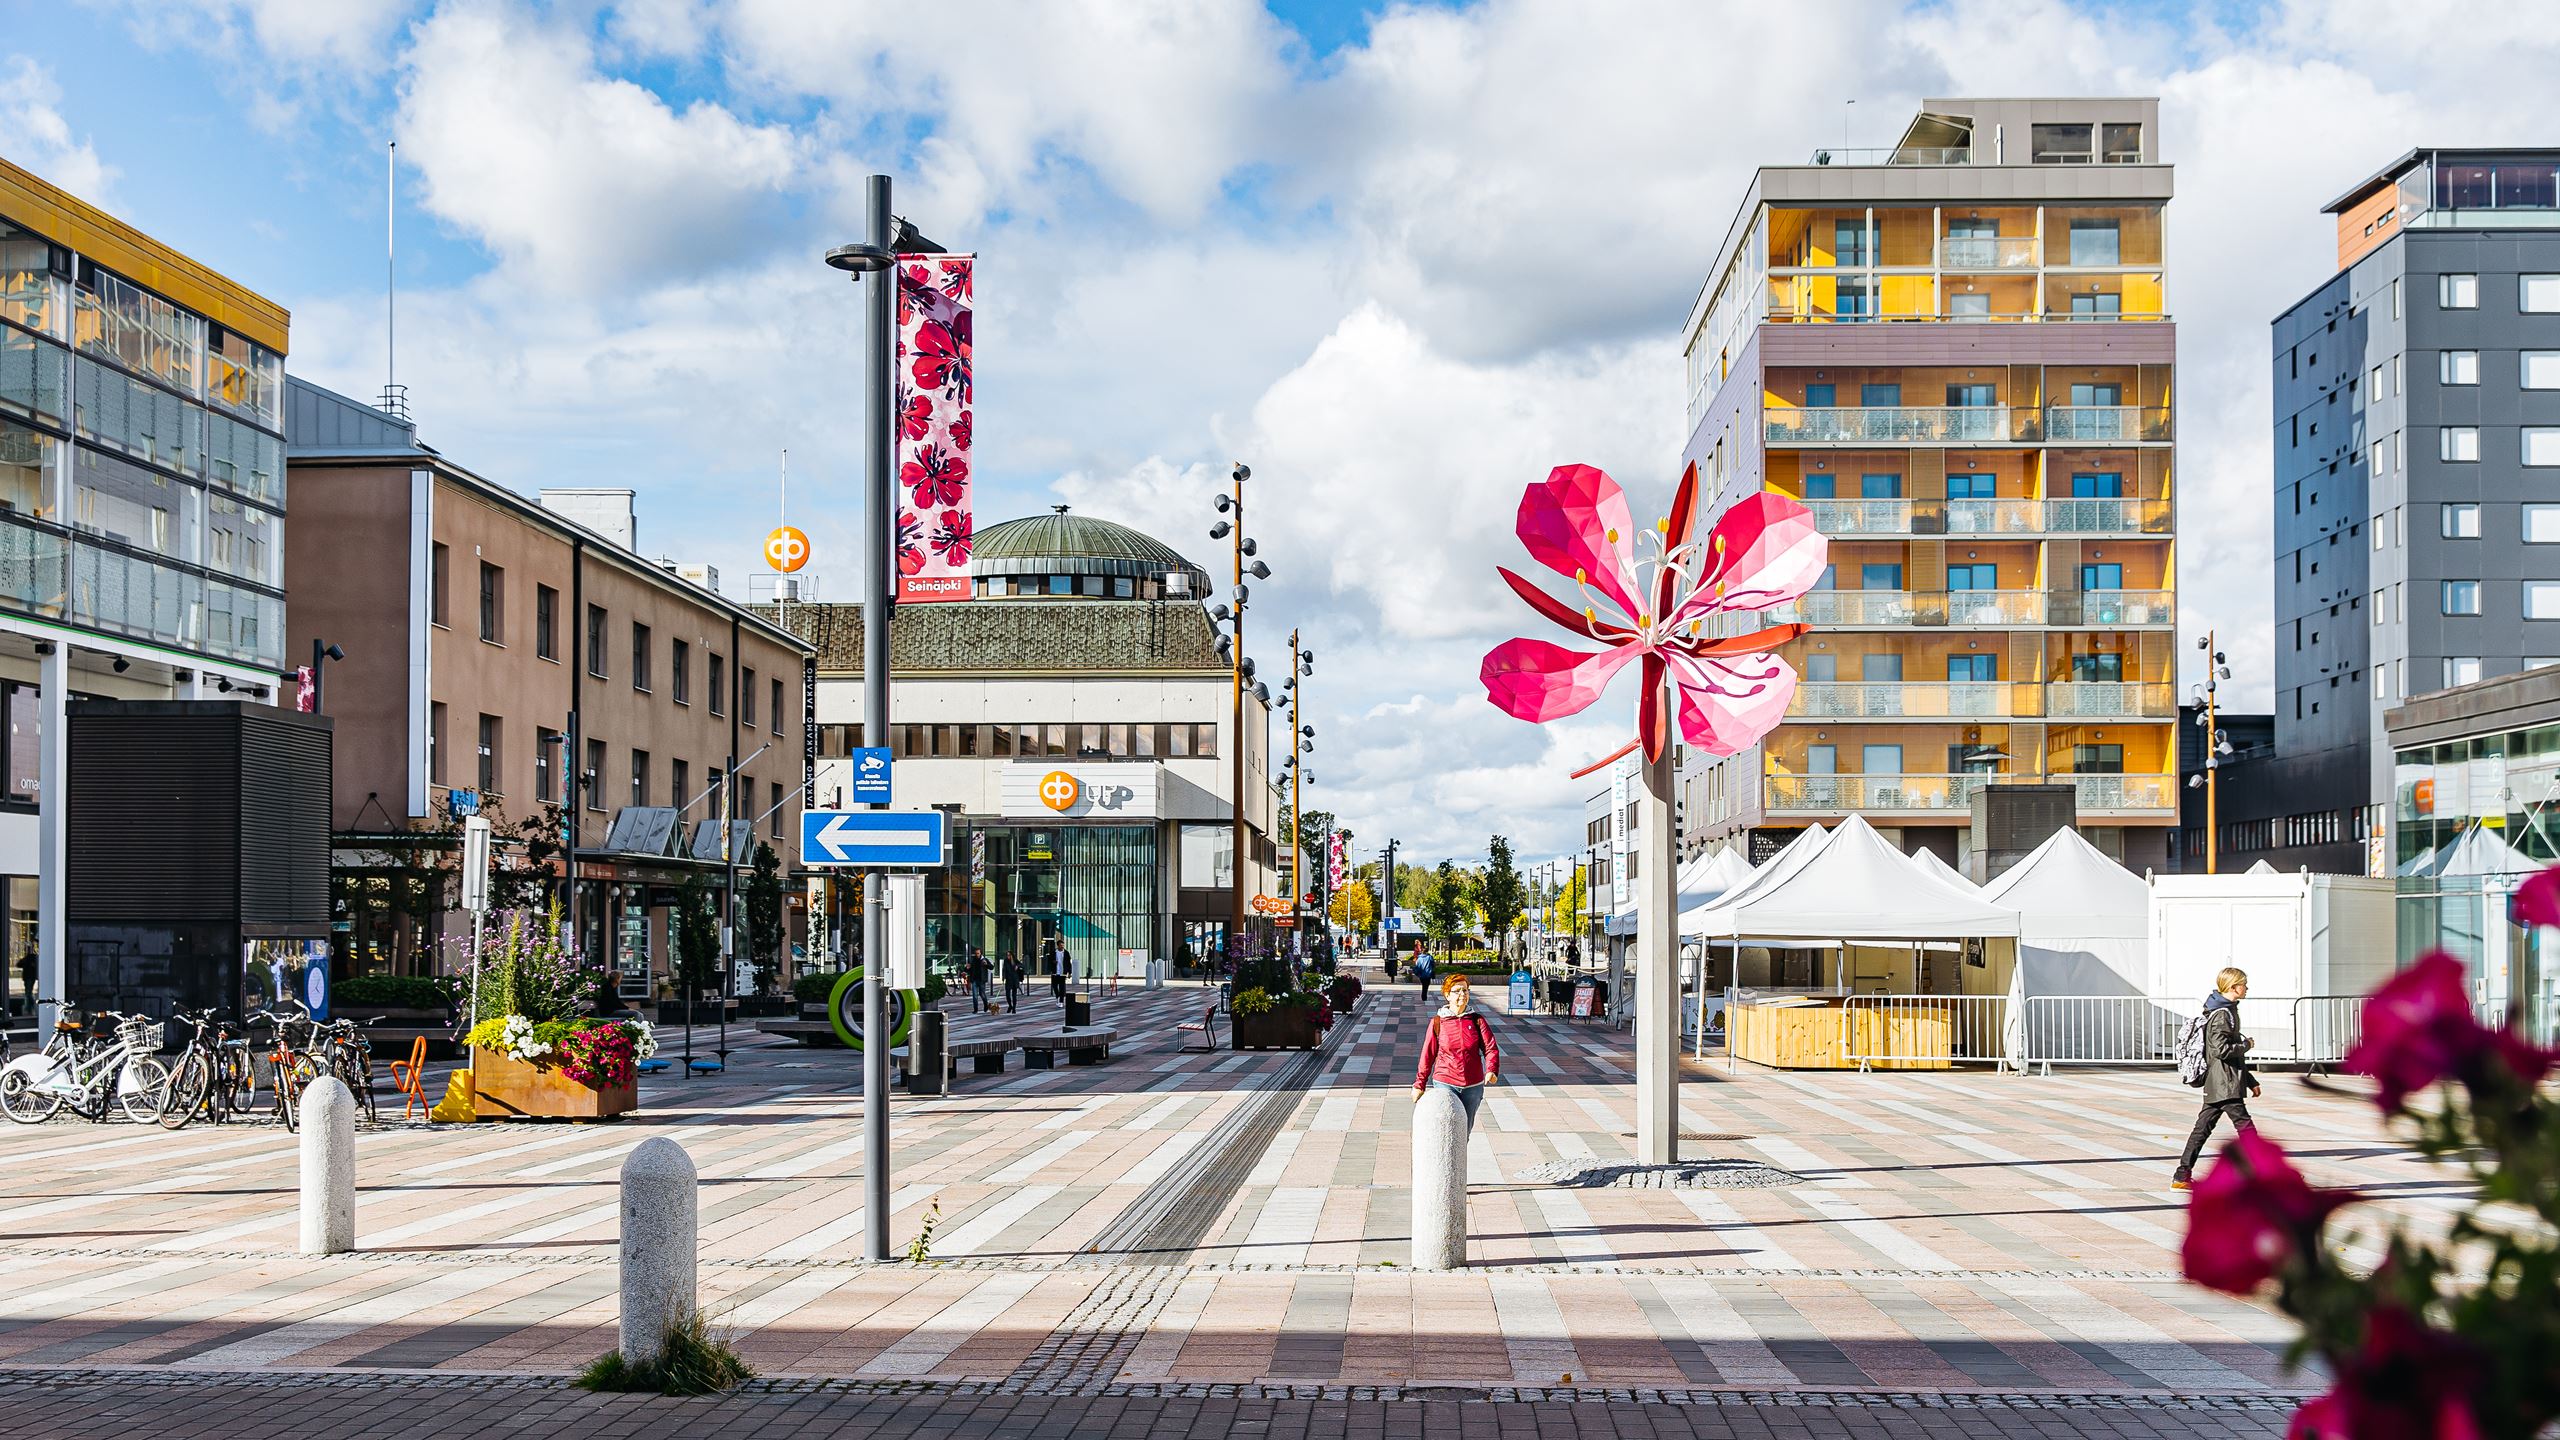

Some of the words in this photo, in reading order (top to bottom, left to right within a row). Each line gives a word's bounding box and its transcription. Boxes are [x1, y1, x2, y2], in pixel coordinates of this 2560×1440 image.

[907, 580, 962, 593] Seinäjoki
[806, 667, 814, 710] JAKAMO
[806, 716, 814, 759] JAKAMO
[806, 765, 814, 808] JAKAMO
